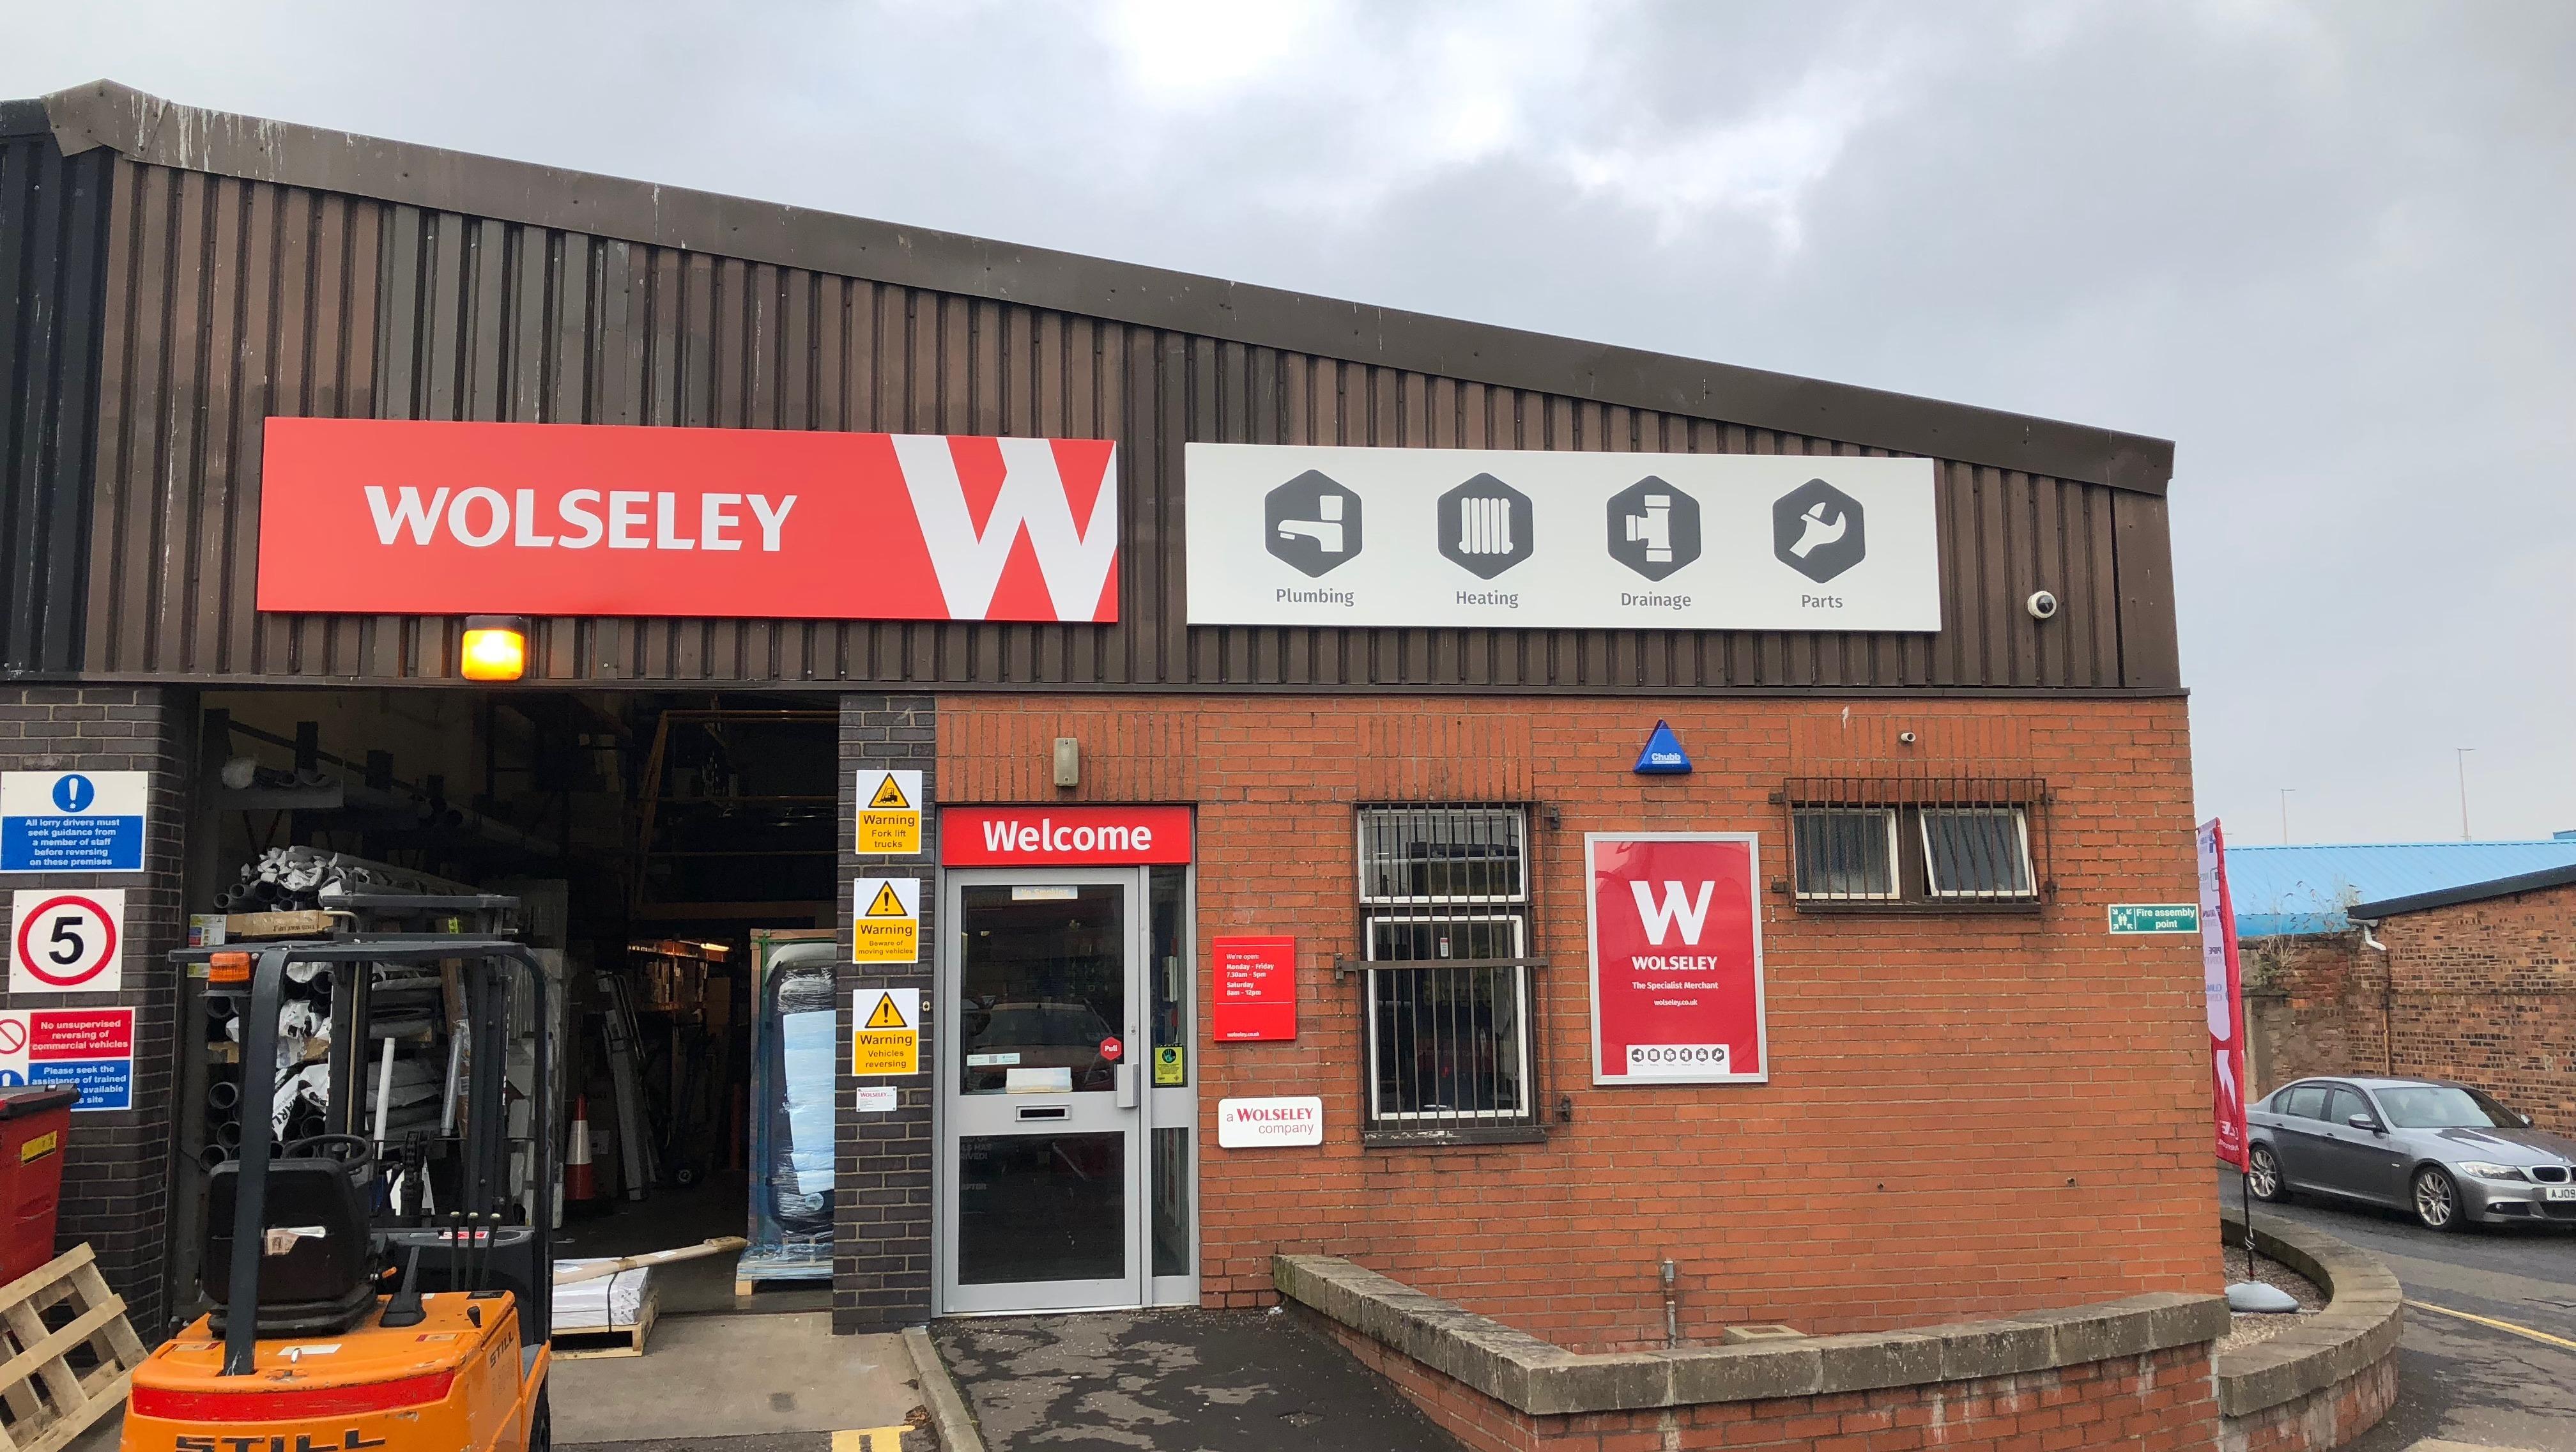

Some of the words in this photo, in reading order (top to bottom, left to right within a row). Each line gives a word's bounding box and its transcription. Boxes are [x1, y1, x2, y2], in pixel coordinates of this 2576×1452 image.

[364, 486, 797, 552] WOLSELEY
[889, 434, 1117, 622] W
[1276, 589, 1354, 607] Plumbing
[1456, 590, 1519, 609] Heating
[1621, 591, 1691, 610] Drainage
[1802, 594, 1843, 608] Parts
[40, 819, 60, 828] lorry
[864, 815, 915, 827] Warning
[51, 829, 92, 838] guidance
[983, 818, 1152, 851] Welcome
[66, 848, 108, 857] reversing
[71, 858, 112, 867] premises
[1629, 881, 1715, 945] W
[2136, 909, 2153, 917] Fire
[2155, 908, 2195, 918] assembly
[861, 924, 912, 936] Warning
[2155, 920, 2178, 930] point
[49, 916, 84, 965] 5
[1255, 962, 1275, 971] Friday
[1631, 956, 1718, 970] WOLSELEY
[1632, 982, 1646, 990] The
[1647, 981, 1683, 991] Specialist
[1683, 981, 1719, 989] Merchant
[1654, 998, 1698, 1007] wolseley.co.uk
[41, 1021, 54, 1030] No
[57, 1019, 121, 1031] unsupervised
[52, 1031, 96, 1040] reversing
[99, 1030, 110, 1039] of
[860, 1034, 912, 1046] Warning
[32, 1041, 87, 1051] commercial
[89, 1040, 128, 1049] vehicles
[44, 1067, 74, 1075] Please
[77, 1065, 98, 1074] seek
[83, 1085, 124, 1093] available
[87, 1095, 104, 1104] site
[1226, 1113, 1234, 1122] a
[1236, 1108, 1314, 1122] WOLSELEY
[1259, 1124, 1314, 1136] company
[2551, 1190, 2576, 1198] AJ09
[490, 1330, 514, 1369] STILL
[176, 1429, 386, 1452] STILL
